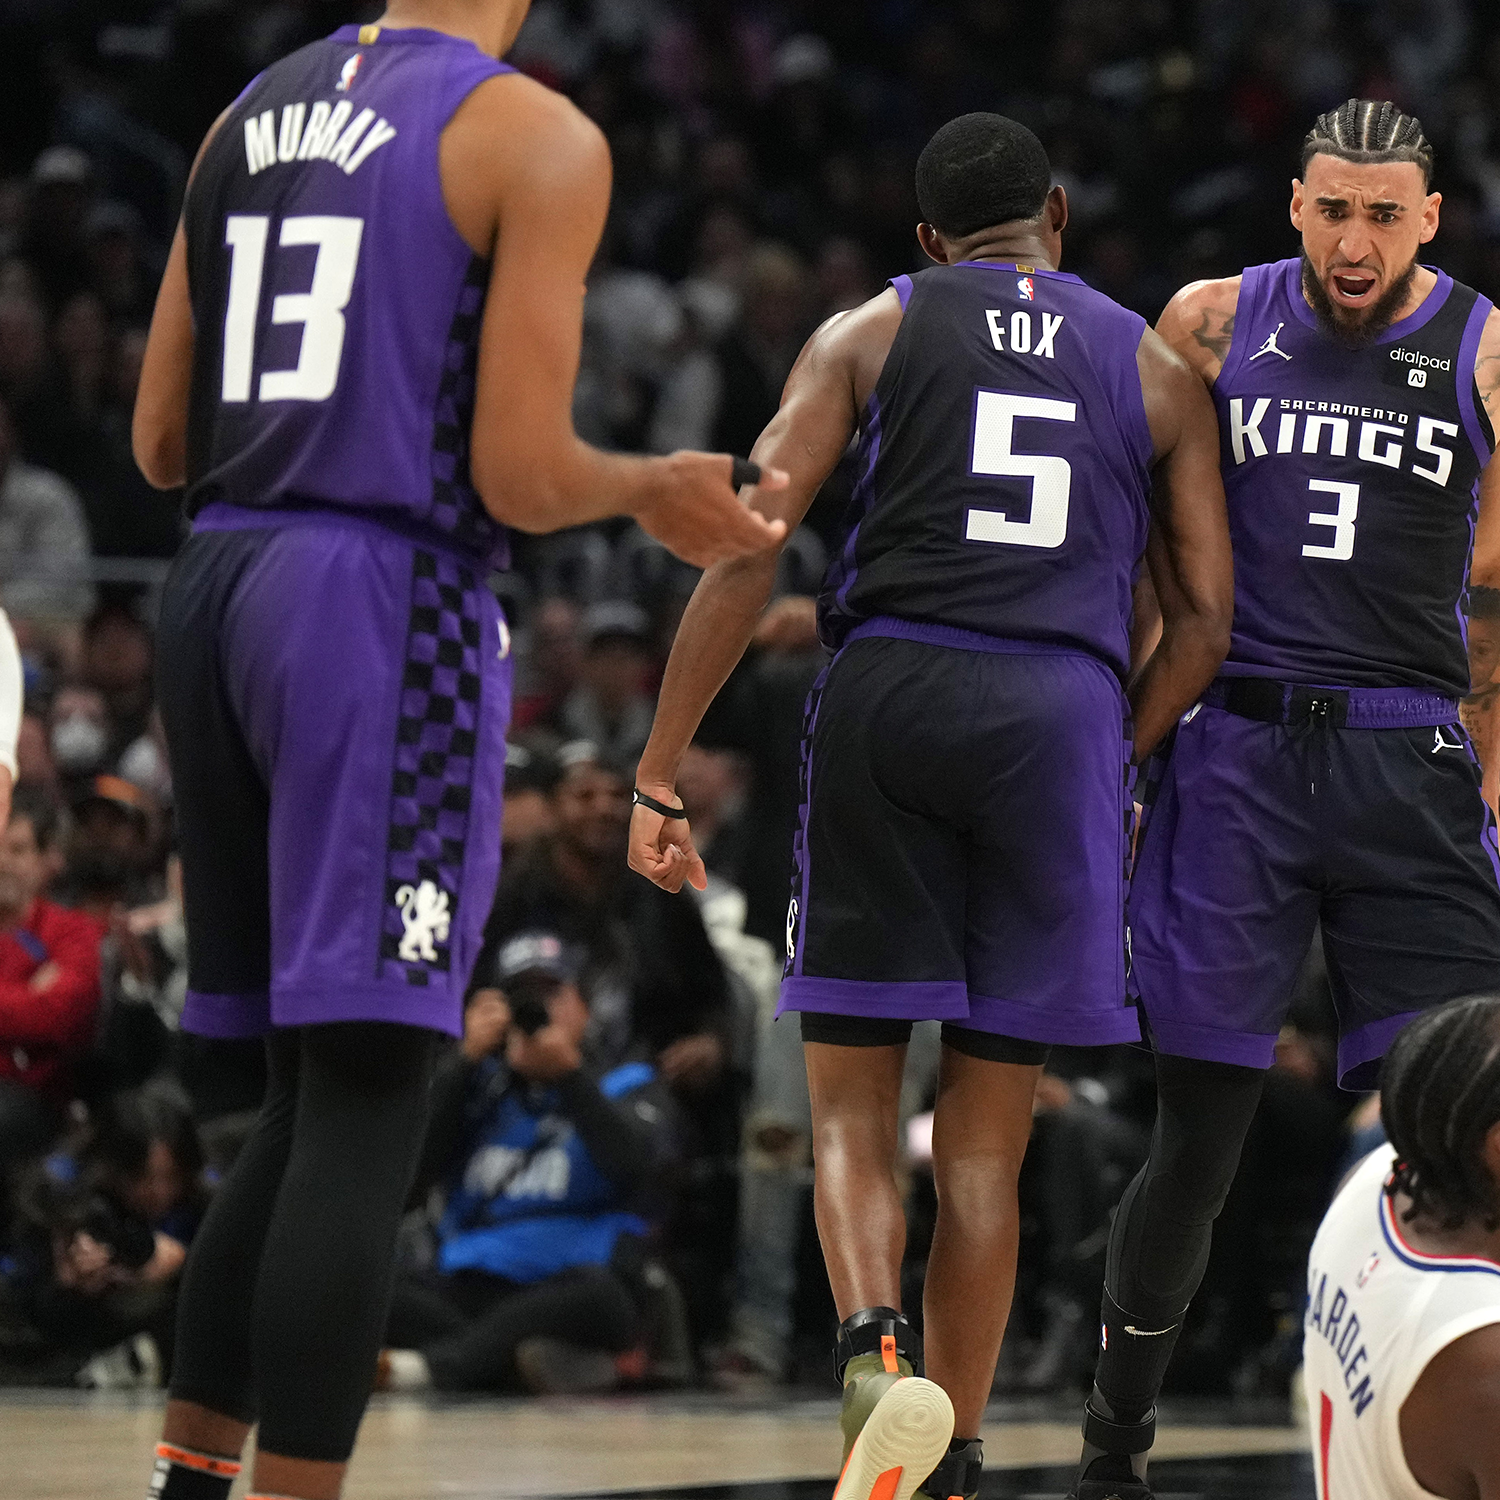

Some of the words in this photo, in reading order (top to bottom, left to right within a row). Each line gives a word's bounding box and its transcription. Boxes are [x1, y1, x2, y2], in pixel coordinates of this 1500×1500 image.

[244, 100, 396, 175] MURRAY
[222, 215, 364, 402] 13
[985, 309, 1064, 359] FOX
[1389, 348, 1451, 372] dialpad
[1229, 397, 1459, 488] KINGS
[1280, 399, 1409, 425] SACRAMENTO
[965, 390, 1077, 548] 5
[1301, 478, 1360, 561] 3
